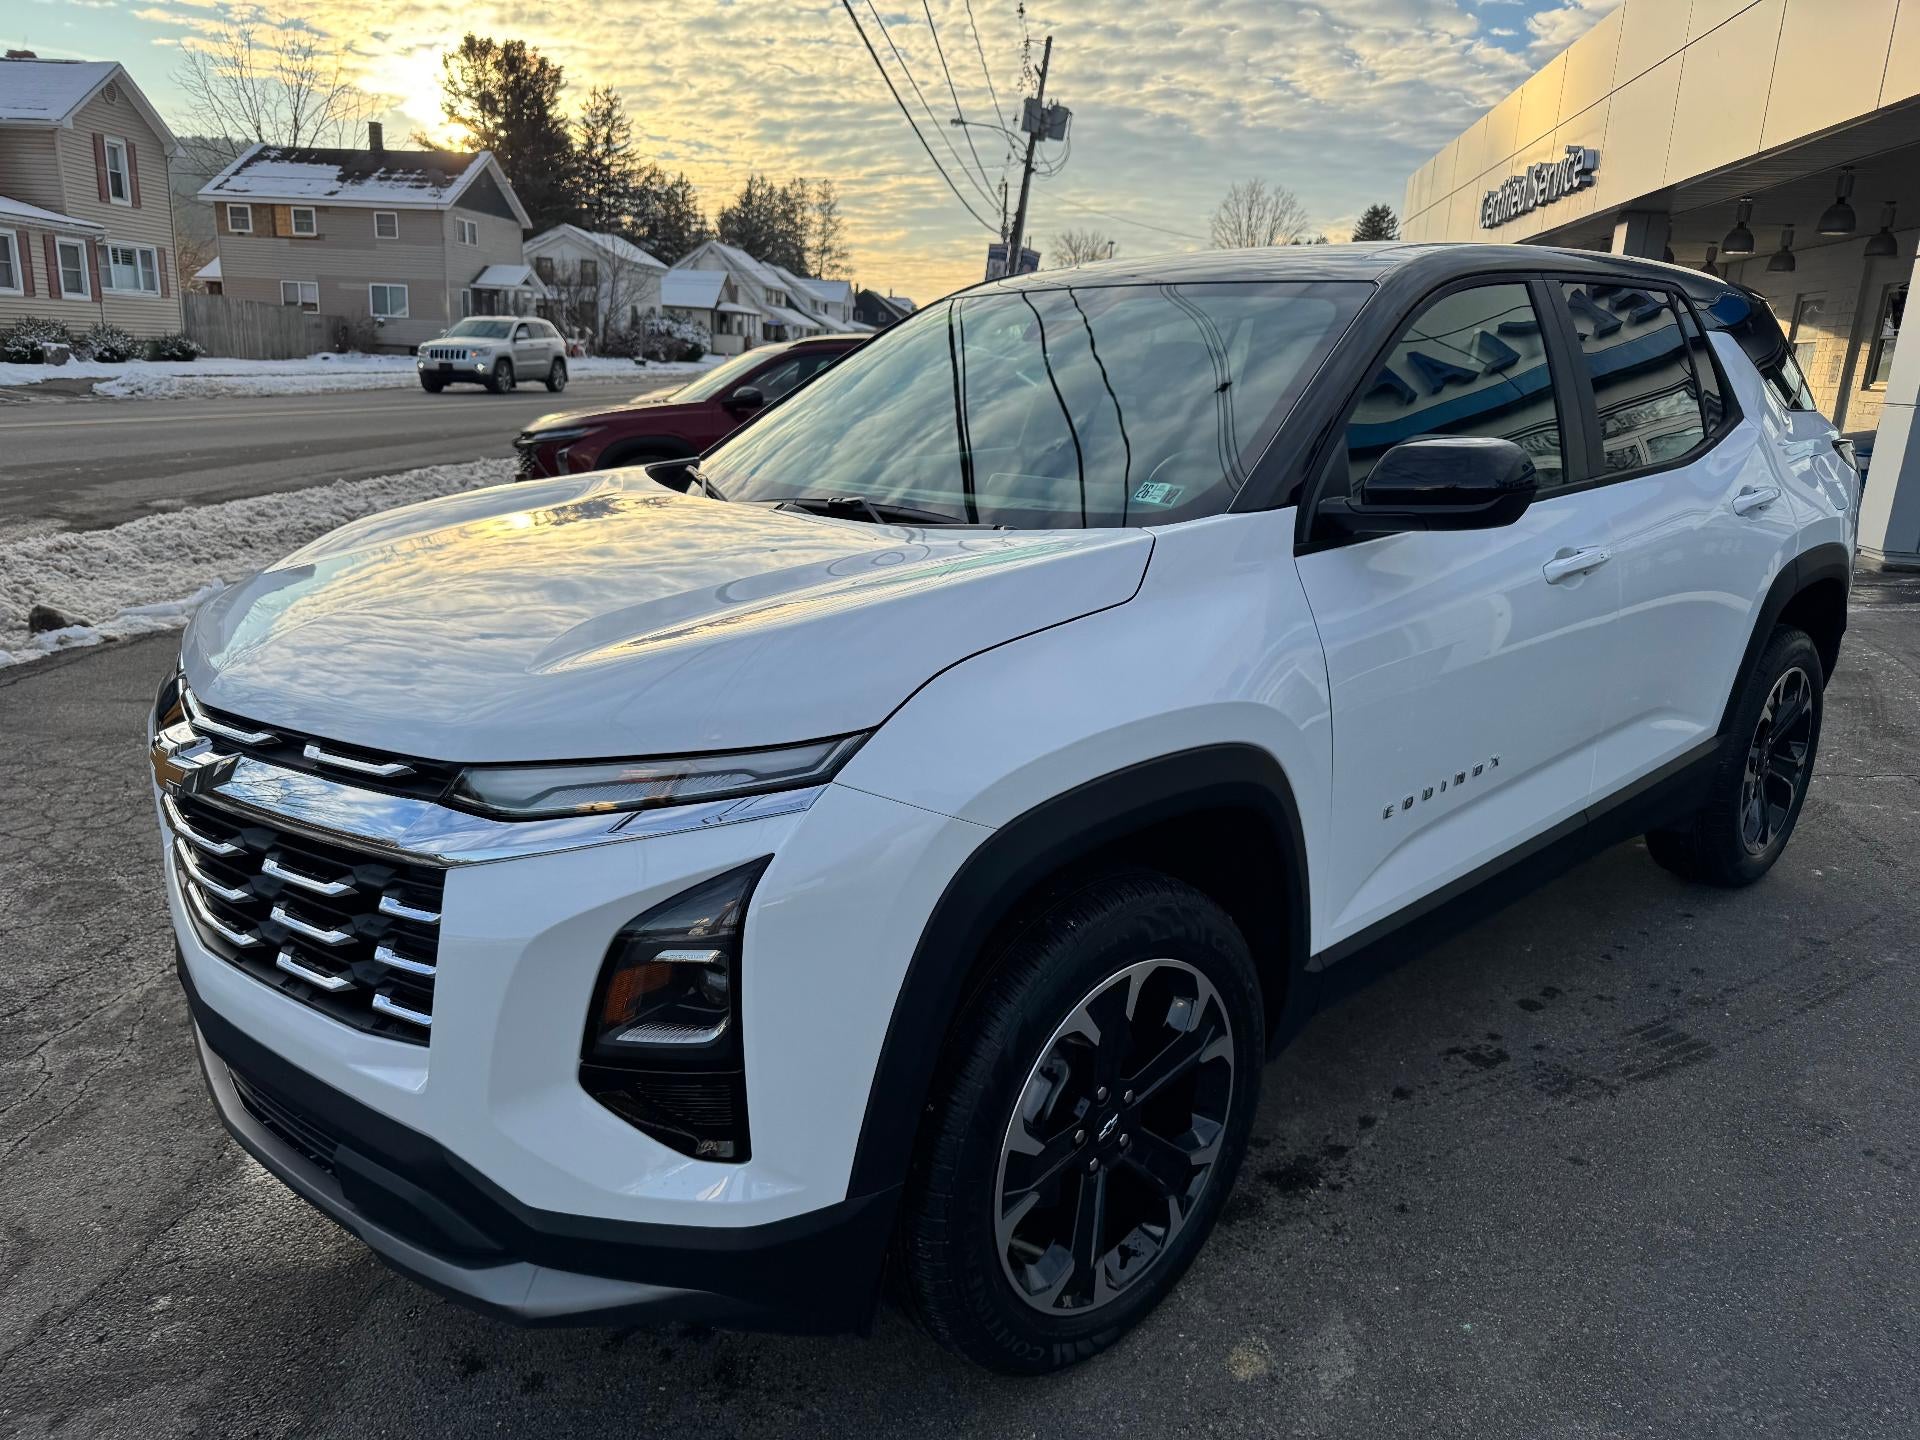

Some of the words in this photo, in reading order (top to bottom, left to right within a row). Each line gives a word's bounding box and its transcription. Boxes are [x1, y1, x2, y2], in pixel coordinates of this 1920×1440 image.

[1480, 166, 1532, 228] Certified
[1529, 147, 1591, 208] Service
[1135, 483, 1155, 499] 26
[1382, 752, 1501, 820] EQUINOX
